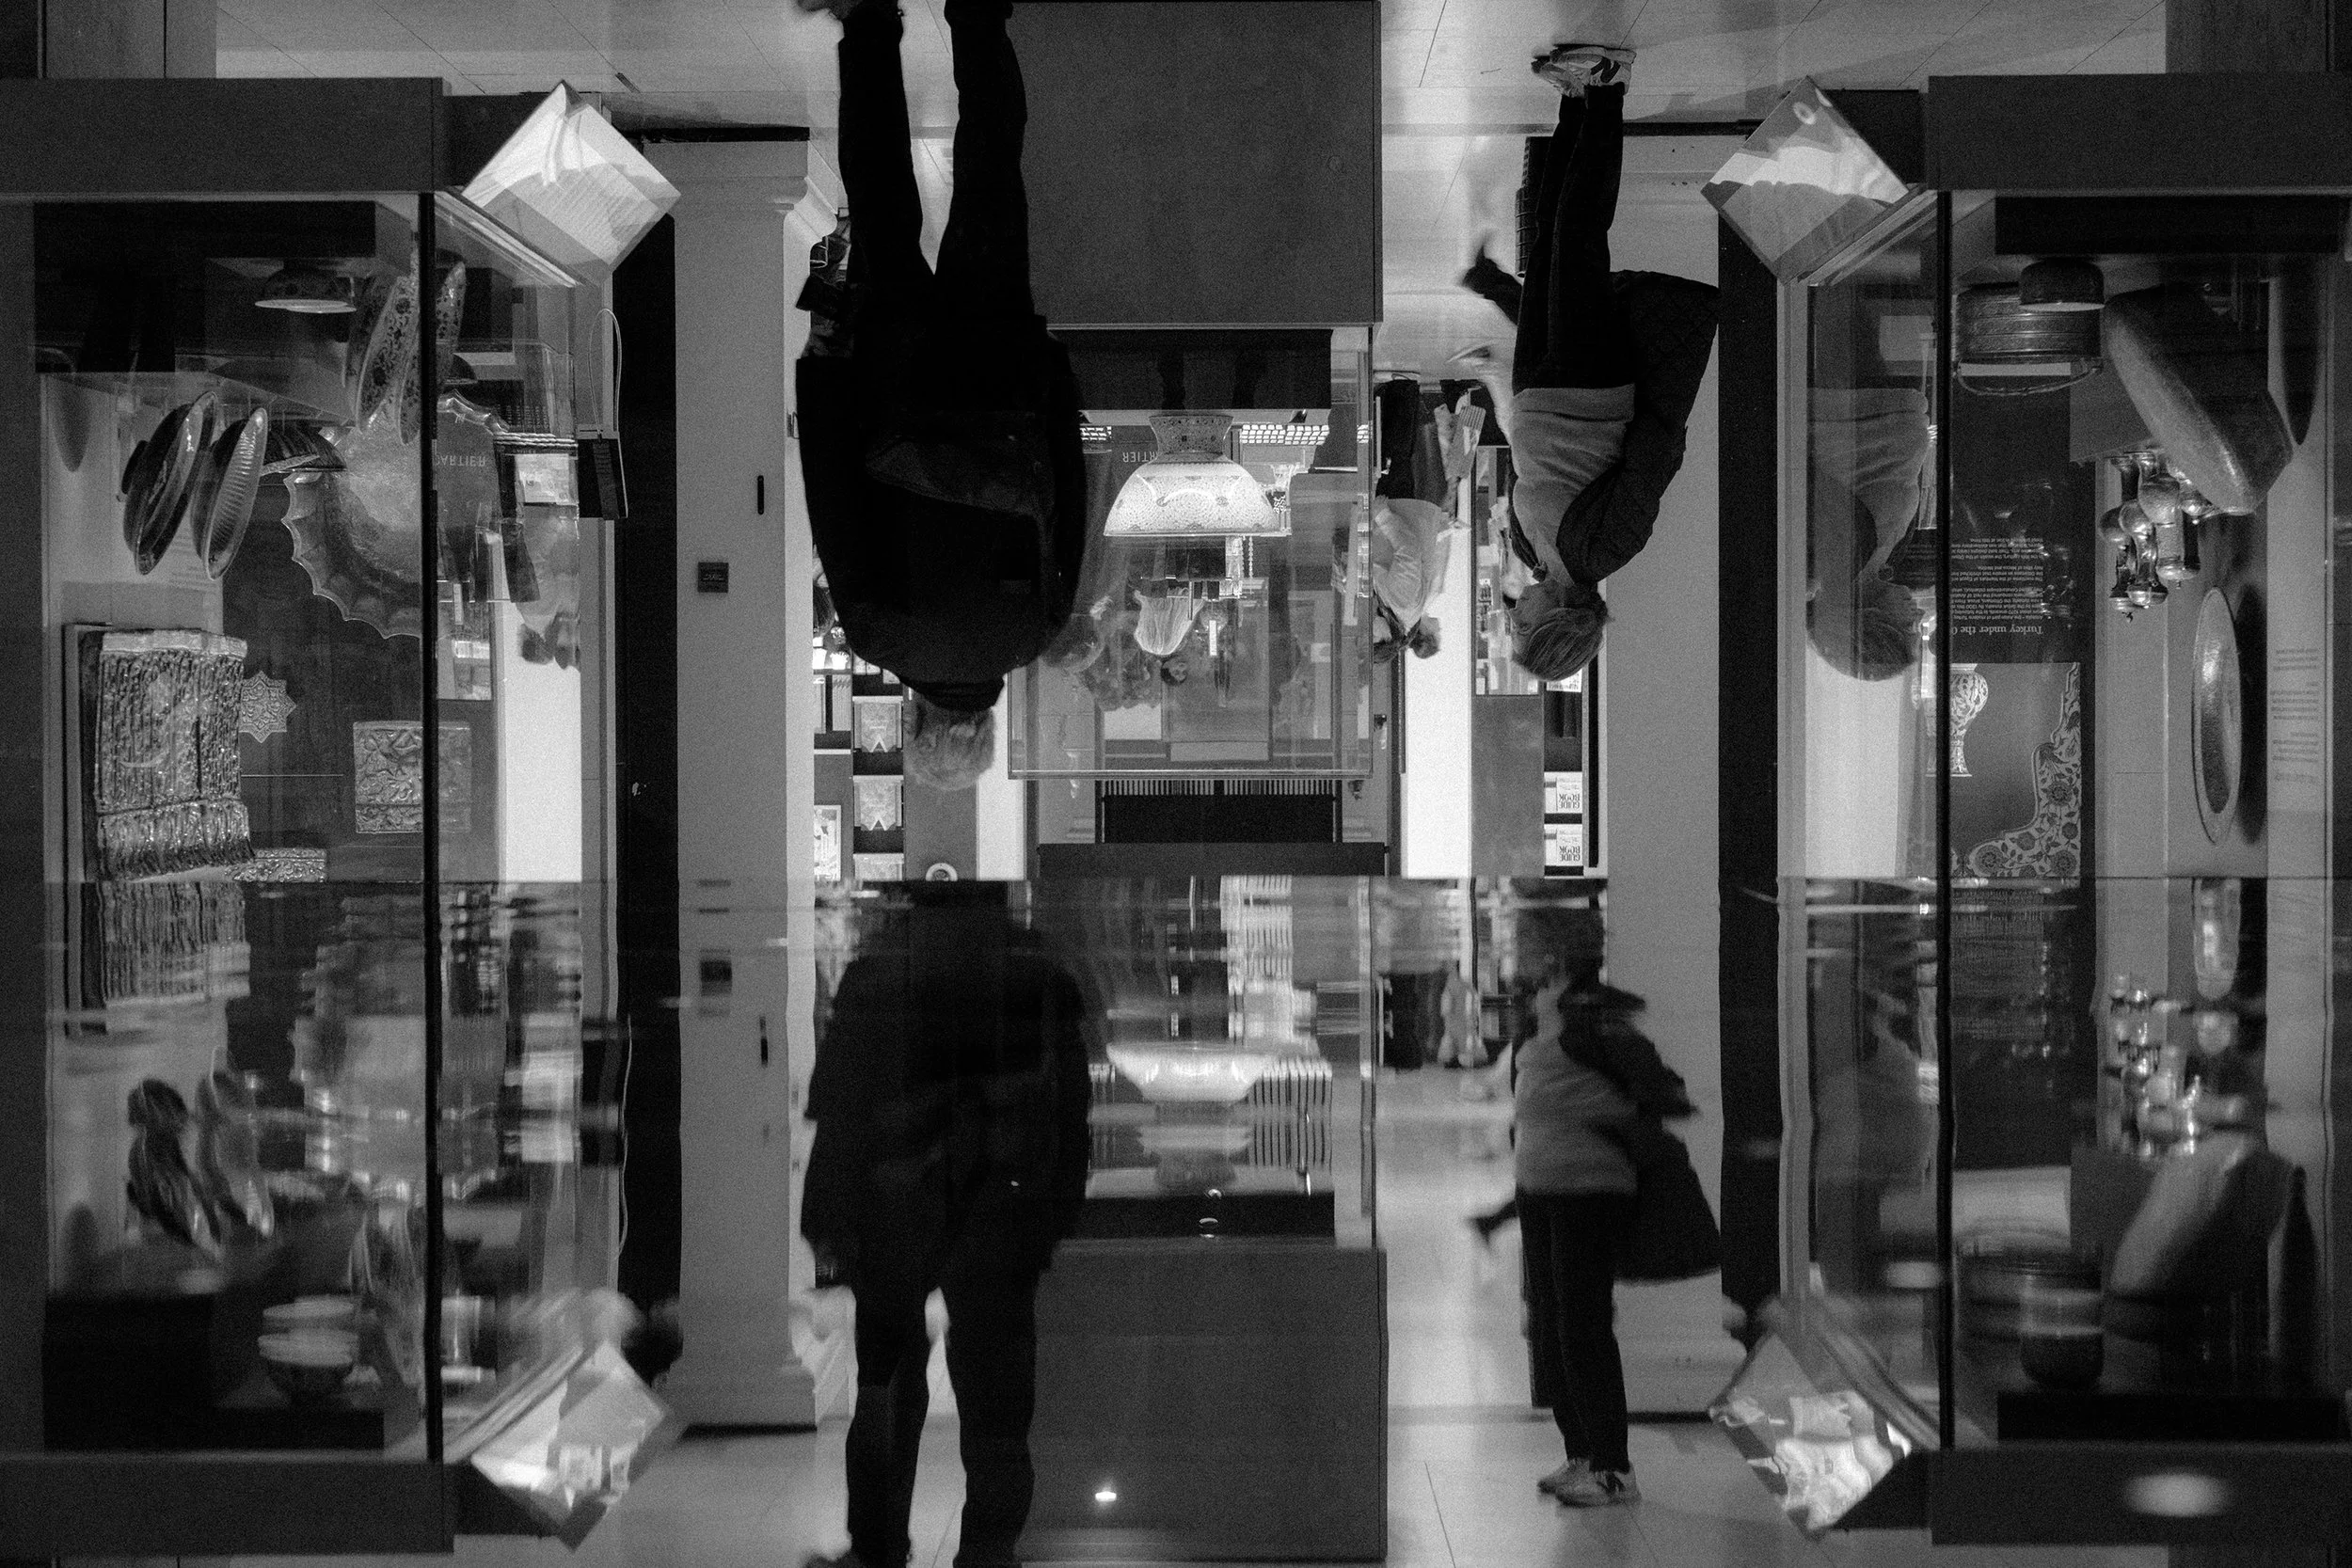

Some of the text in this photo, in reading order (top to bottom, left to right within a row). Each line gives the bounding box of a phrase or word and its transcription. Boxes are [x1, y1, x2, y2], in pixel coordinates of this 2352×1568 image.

[1961, 626, 1976, 635] the
[1979, 626, 2007, 635] under
[2010, 624, 2043, 635] Turkey
[1559, 846, 1581, 854] BOOK
